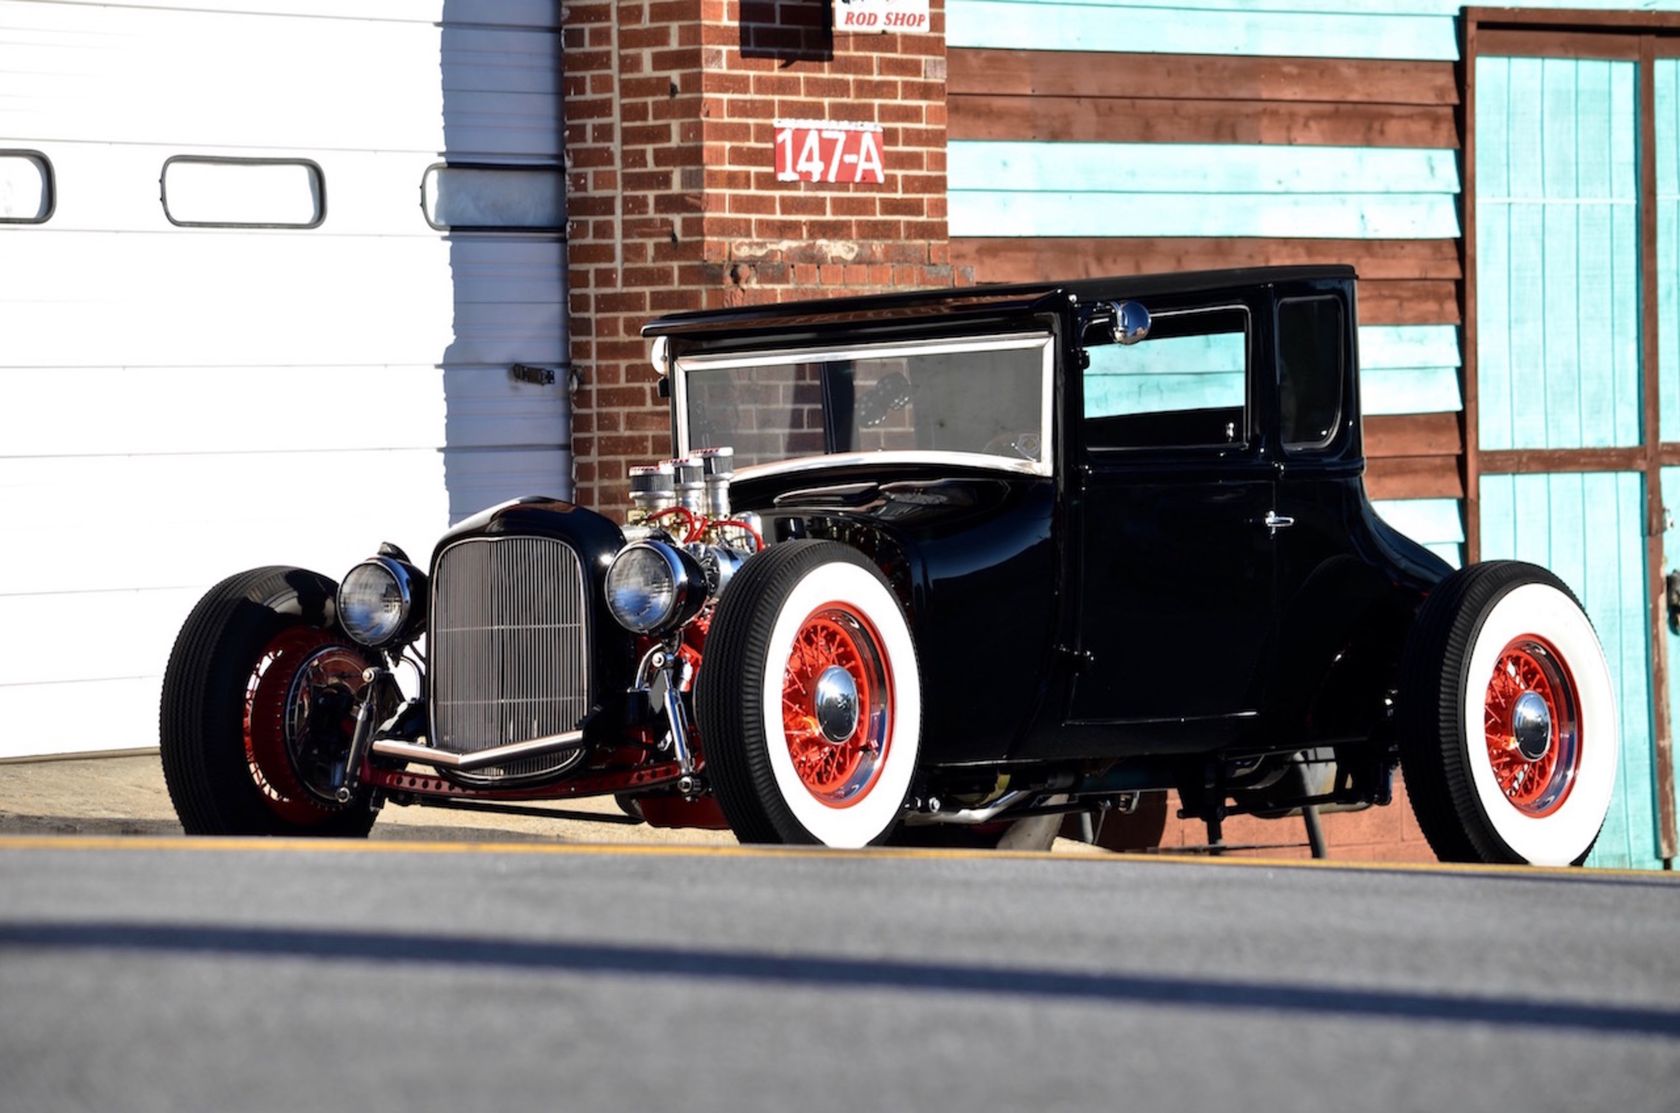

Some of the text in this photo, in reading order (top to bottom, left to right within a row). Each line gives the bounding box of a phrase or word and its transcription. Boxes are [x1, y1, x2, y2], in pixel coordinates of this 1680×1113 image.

[844, 12, 926, 27] ROD SHOP
[776, 128, 884, 183] 147-A
